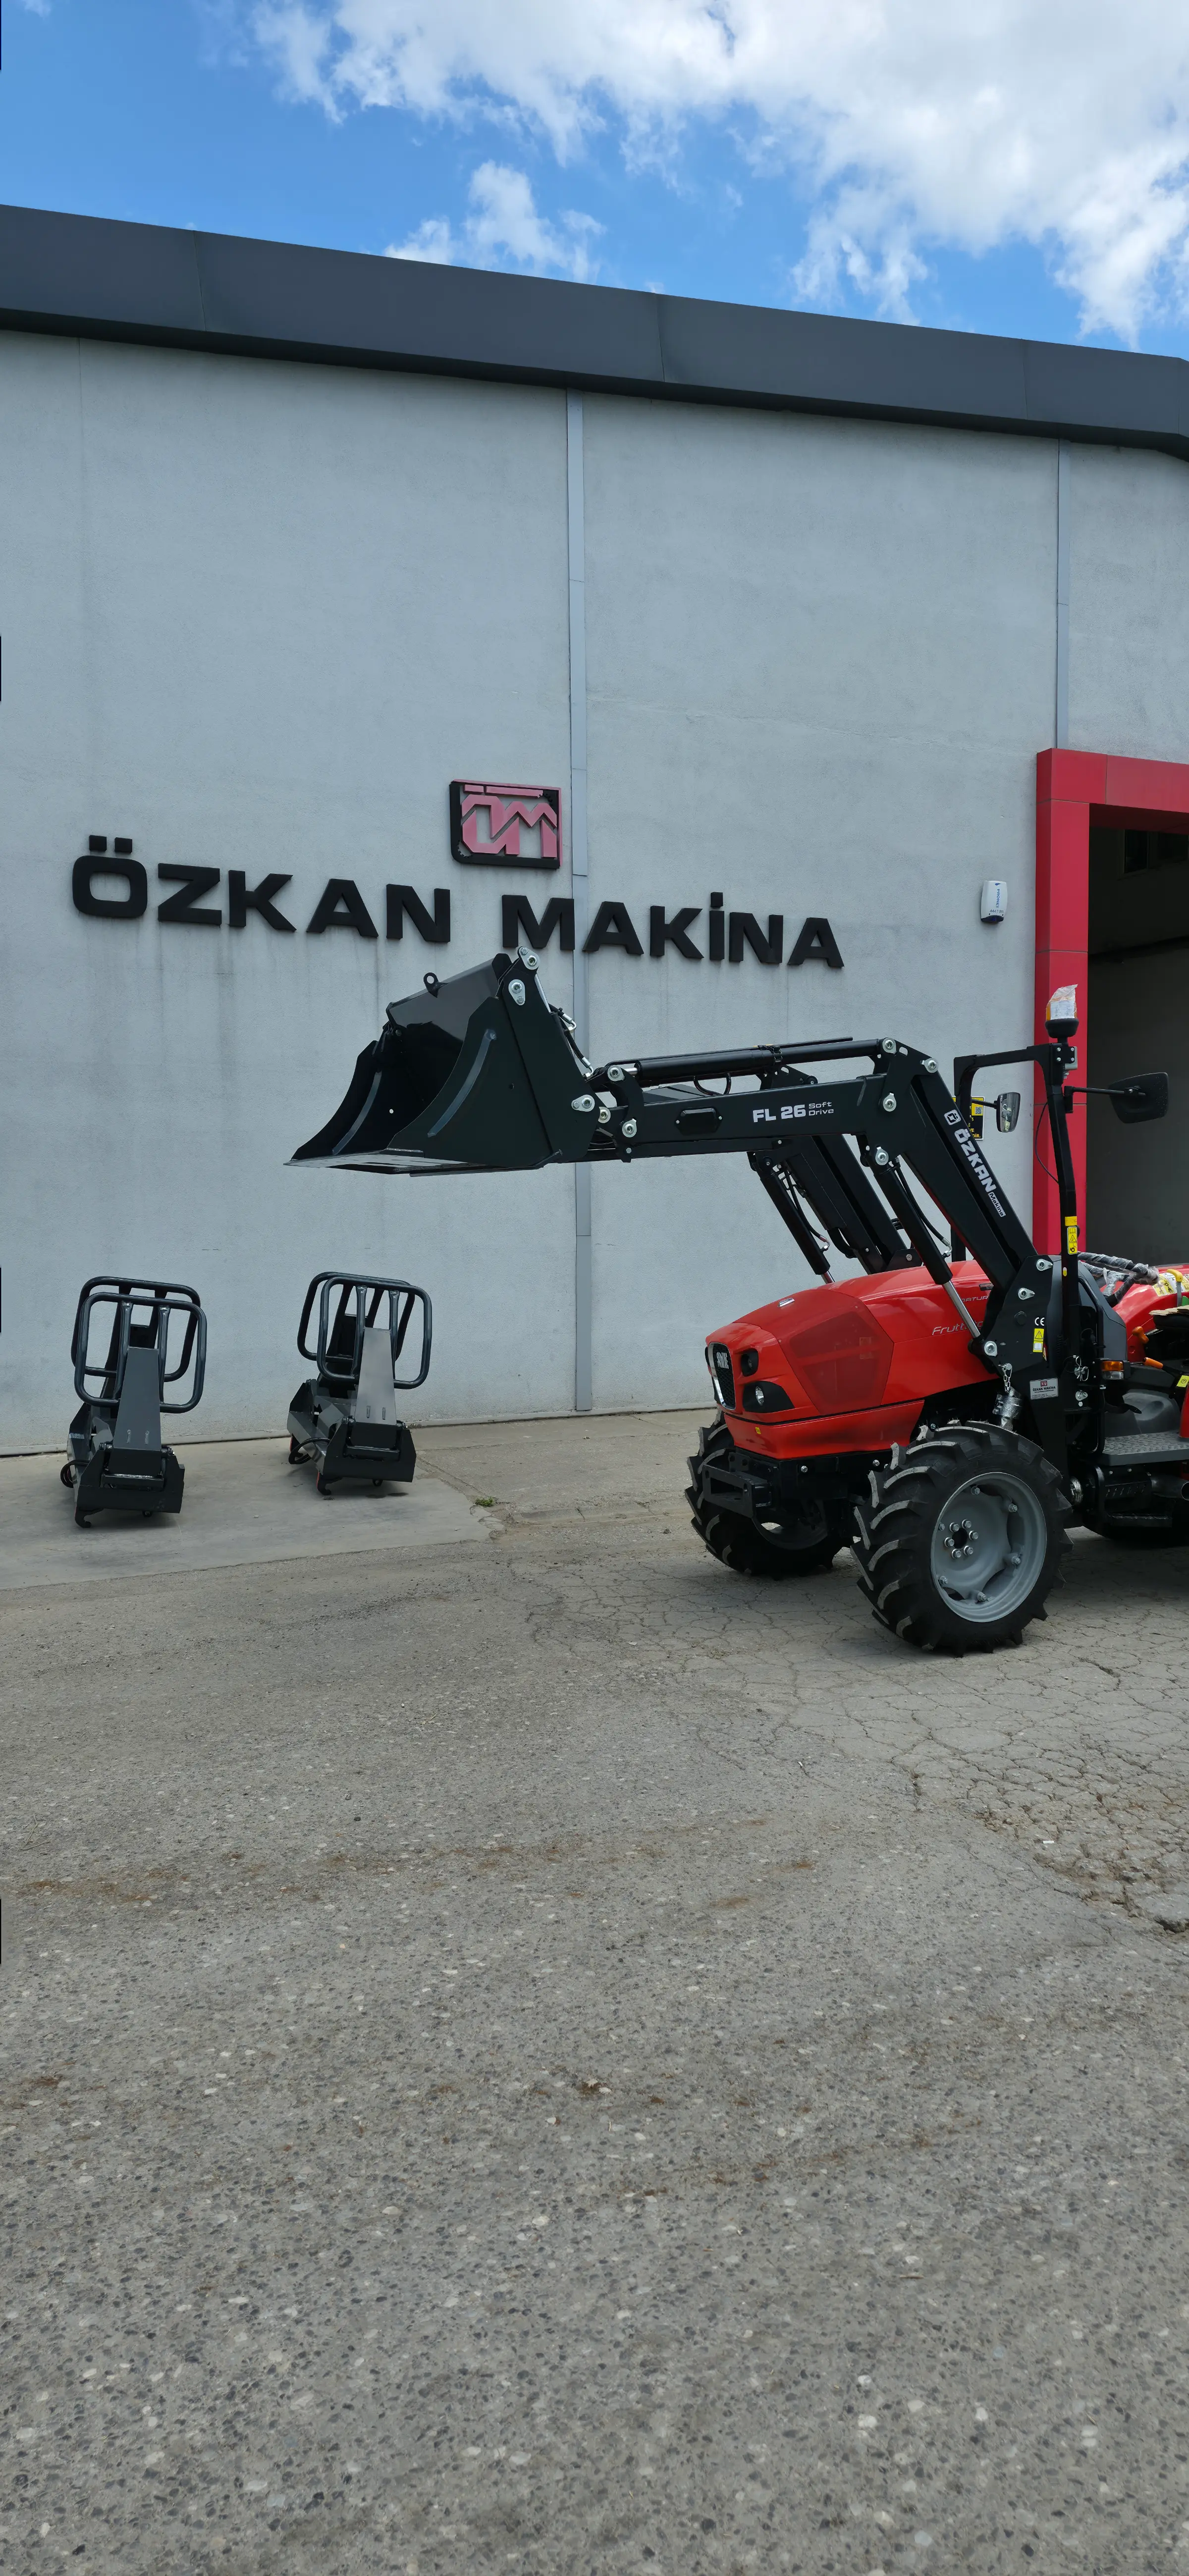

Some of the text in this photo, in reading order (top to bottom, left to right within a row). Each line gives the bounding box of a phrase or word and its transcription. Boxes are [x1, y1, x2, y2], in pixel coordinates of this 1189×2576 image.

[72, 835, 845, 967] ÖZKAN MAKİNA
[753, 1104, 806, 1123] FL 26
[954, 1128, 997, 1192] ÖZKAN
[989, 1193, 1004, 1216] Makina
[1034, 1317, 1045, 1326] CE
[716, 1352, 729, 1369] SAME
